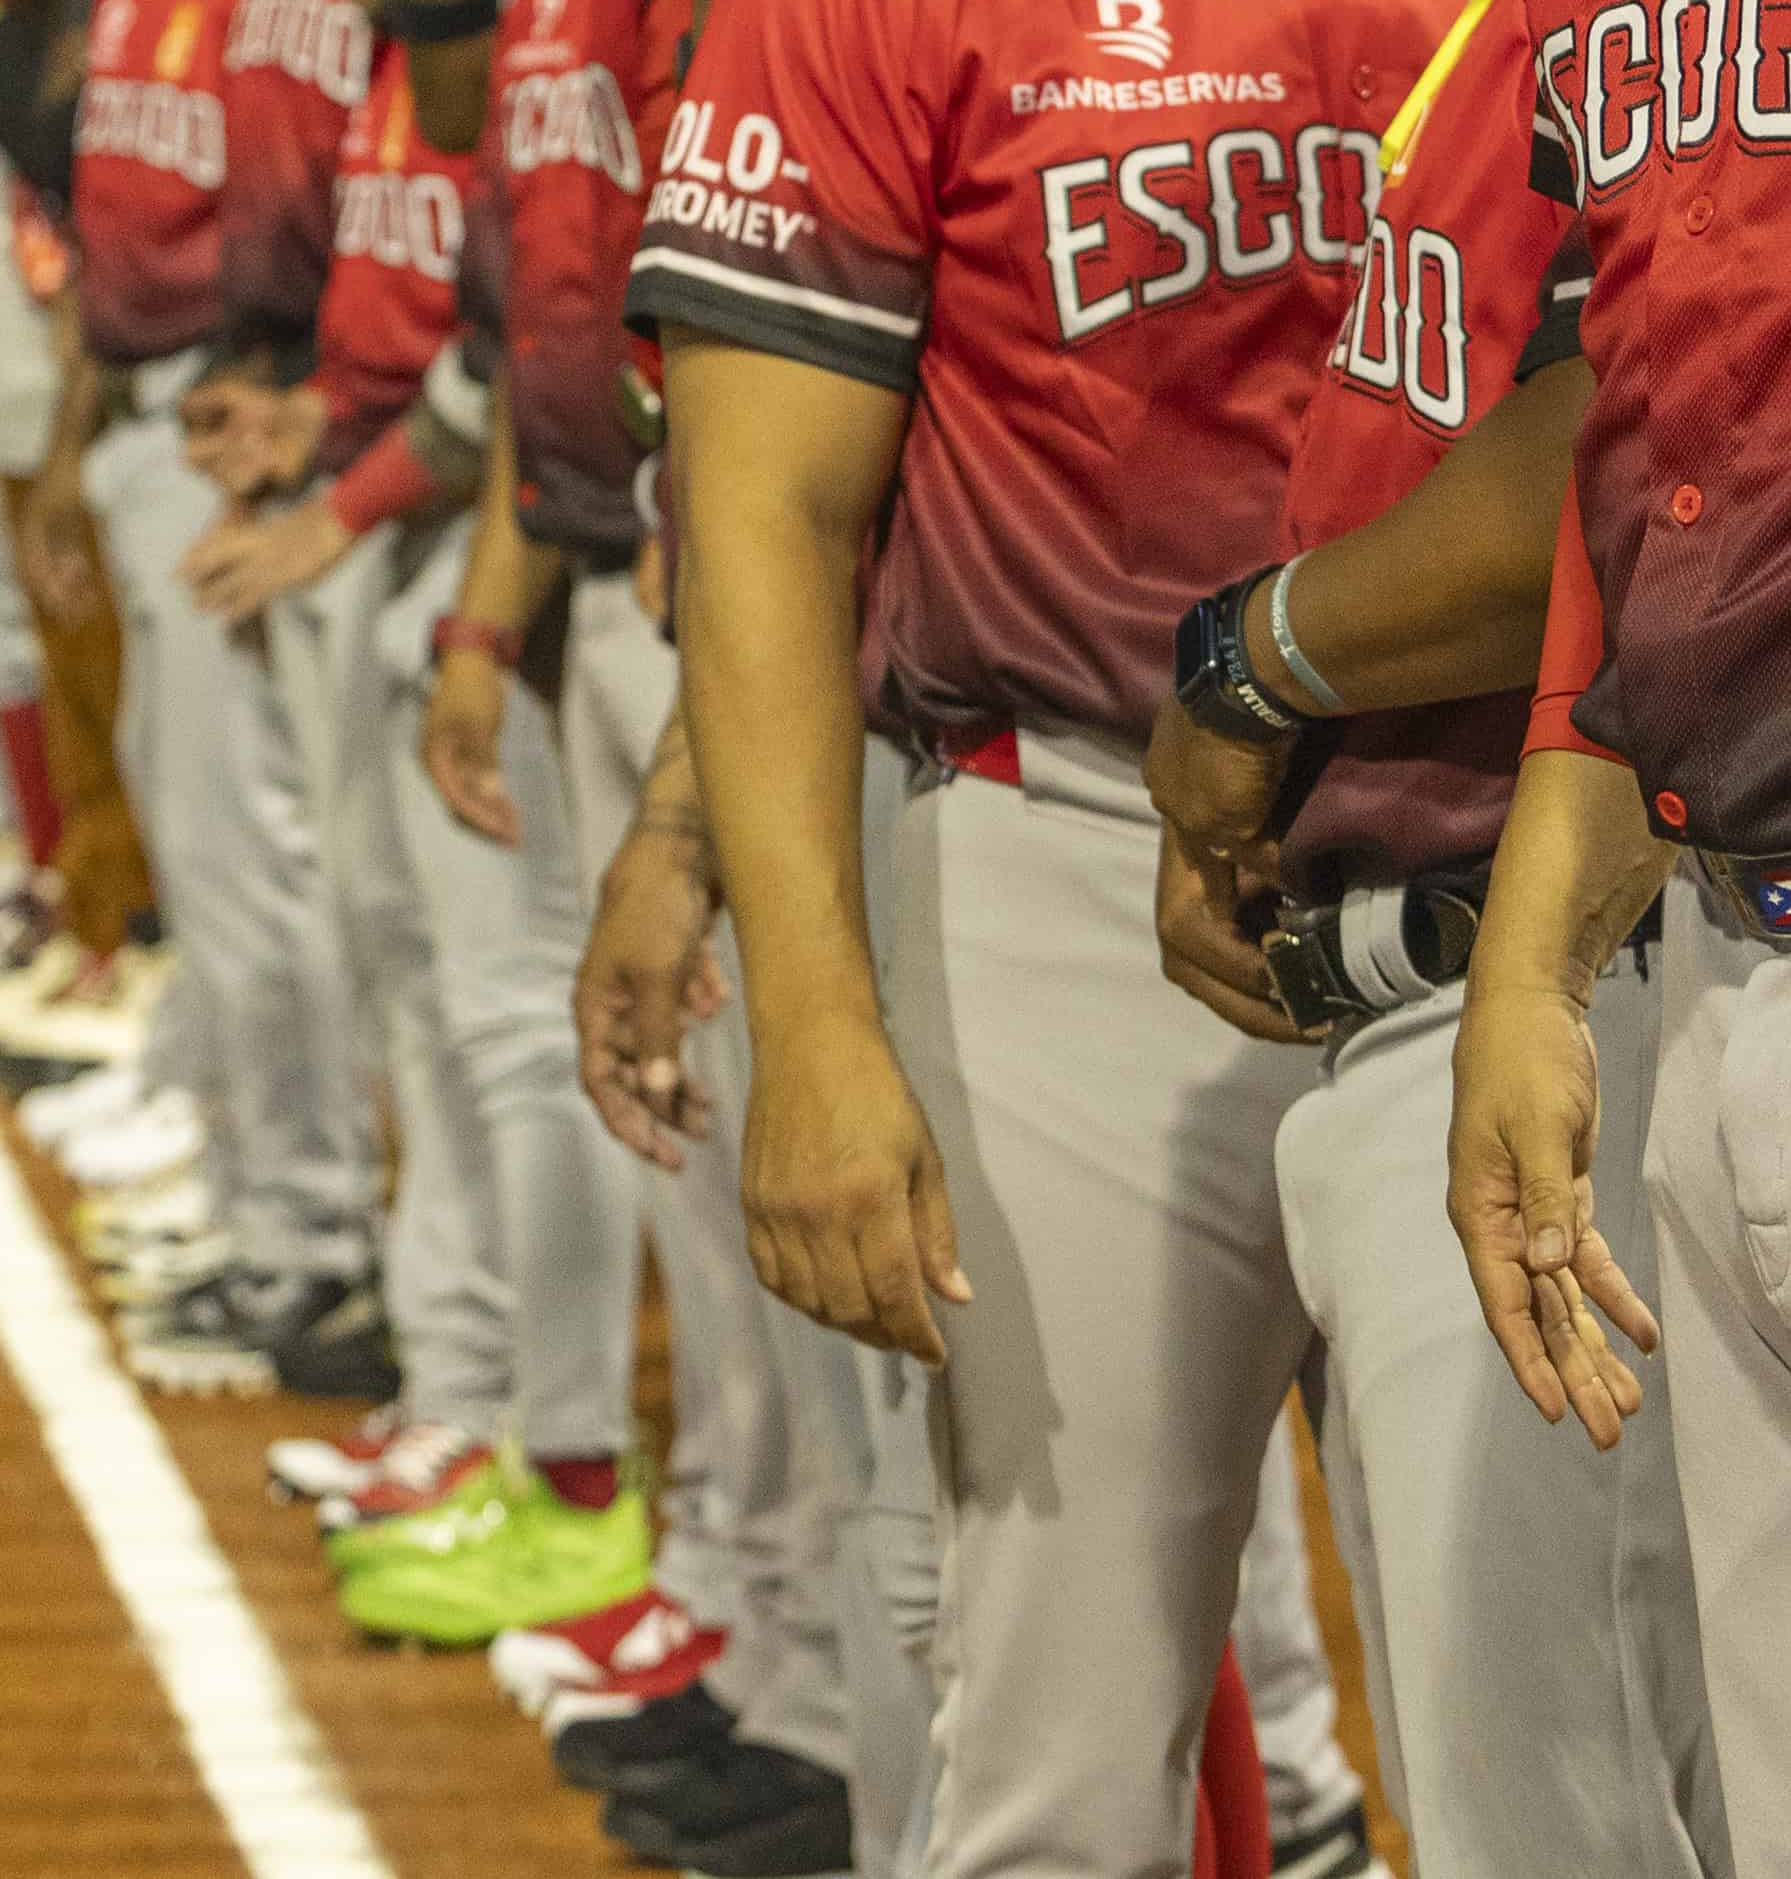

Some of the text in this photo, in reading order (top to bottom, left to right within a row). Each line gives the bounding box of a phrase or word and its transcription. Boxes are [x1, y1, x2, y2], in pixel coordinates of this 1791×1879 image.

[660, 99, 811, 194] OLO-
[1010, 71, 1286, 115] BANRESERVAS
[1039, 123, 1384, 346] ESCO
[1329, 217, 1469, 431] DO
